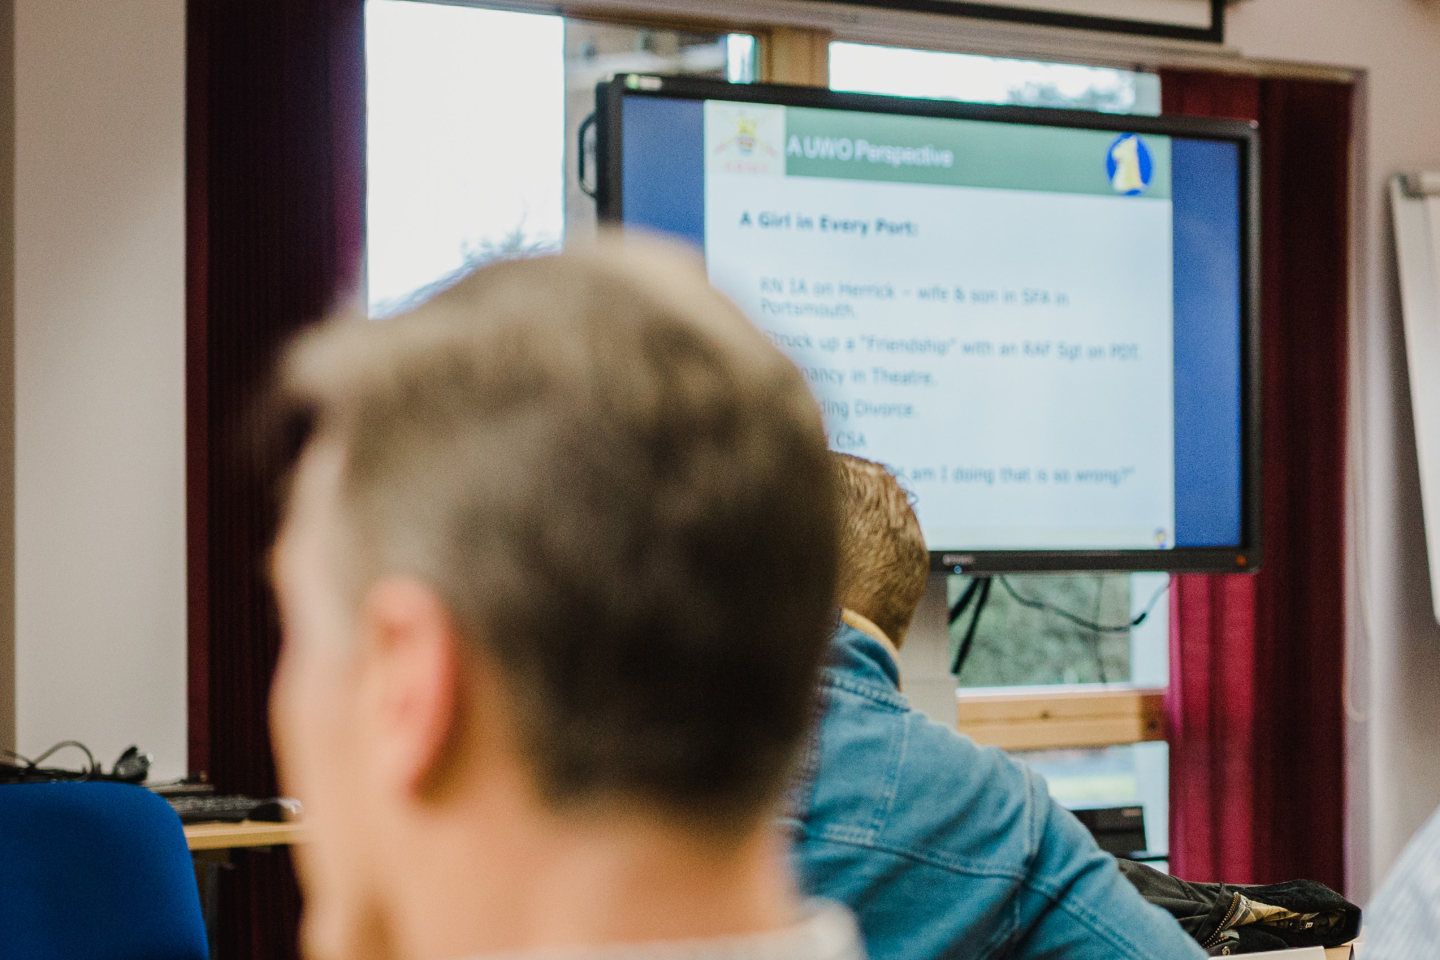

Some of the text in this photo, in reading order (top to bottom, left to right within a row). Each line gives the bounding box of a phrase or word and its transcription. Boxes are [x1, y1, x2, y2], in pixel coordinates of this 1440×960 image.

[787, 135, 954, 168] A UWO Perspective
[740, 211, 918, 236] A Girl in Every Port:
[813, 282, 833, 297] on
[838, 281, 895, 300] Herrick
[917, 283, 948, 300] wife
[970, 289, 998, 303] son
[1003, 288, 1018, 304] in
[1056, 291, 1070, 306] in
[761, 298, 857, 319] Portsmouth.
[763, 329, 812, 349] Struck
[820, 337, 839, 352] up
[845, 338, 855, 350] a
[961, 341, 994, 355] with
[1000, 343, 1018, 357] an
[1022, 341, 1051, 357] RAF
[1087, 347, 1106, 359] on
[803, 366, 937, 386] nancy in Theatre.
[854, 399, 919, 418] Divorce.
[836, 430, 866, 448] CSA
[912, 467, 935, 482] am
[953, 466, 994, 487] doing
[1001, 466, 1031, 483] that
[1037, 467, 1047, 483] is
[1053, 469, 1071, 483] so
